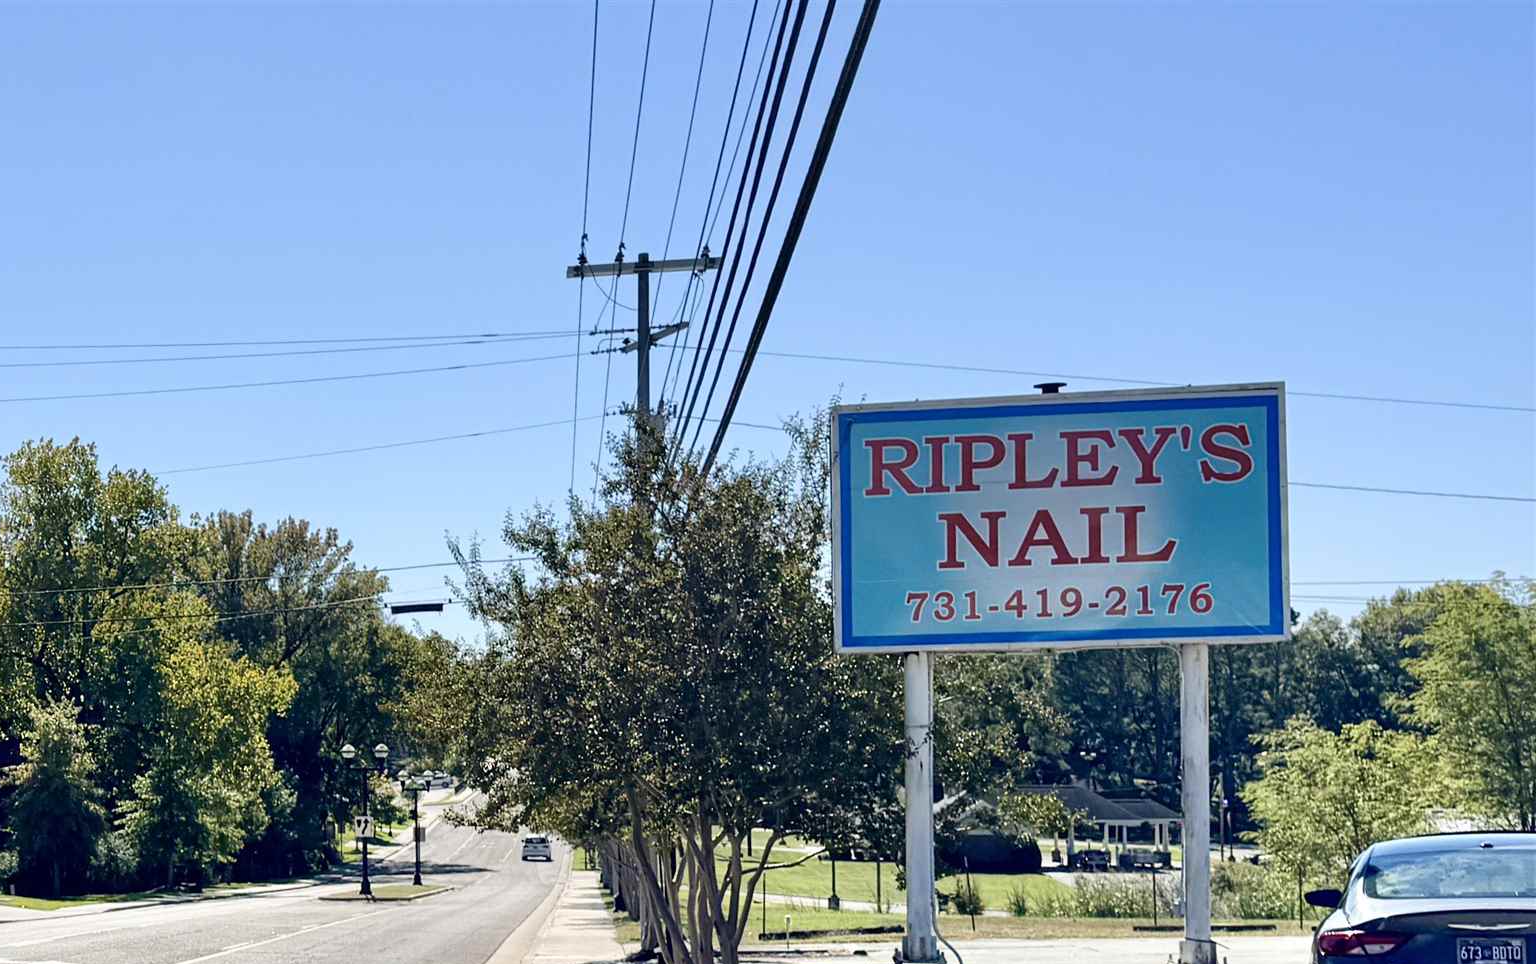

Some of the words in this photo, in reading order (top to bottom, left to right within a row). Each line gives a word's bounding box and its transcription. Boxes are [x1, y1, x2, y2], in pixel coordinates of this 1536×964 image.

[863, 422, 1254, 497] RIPLEY'S
[937, 504, 1177, 570] NAIL
[905, 582, 1215, 623] 731-419-2176
[1461, 946, 1482, 960] 673
